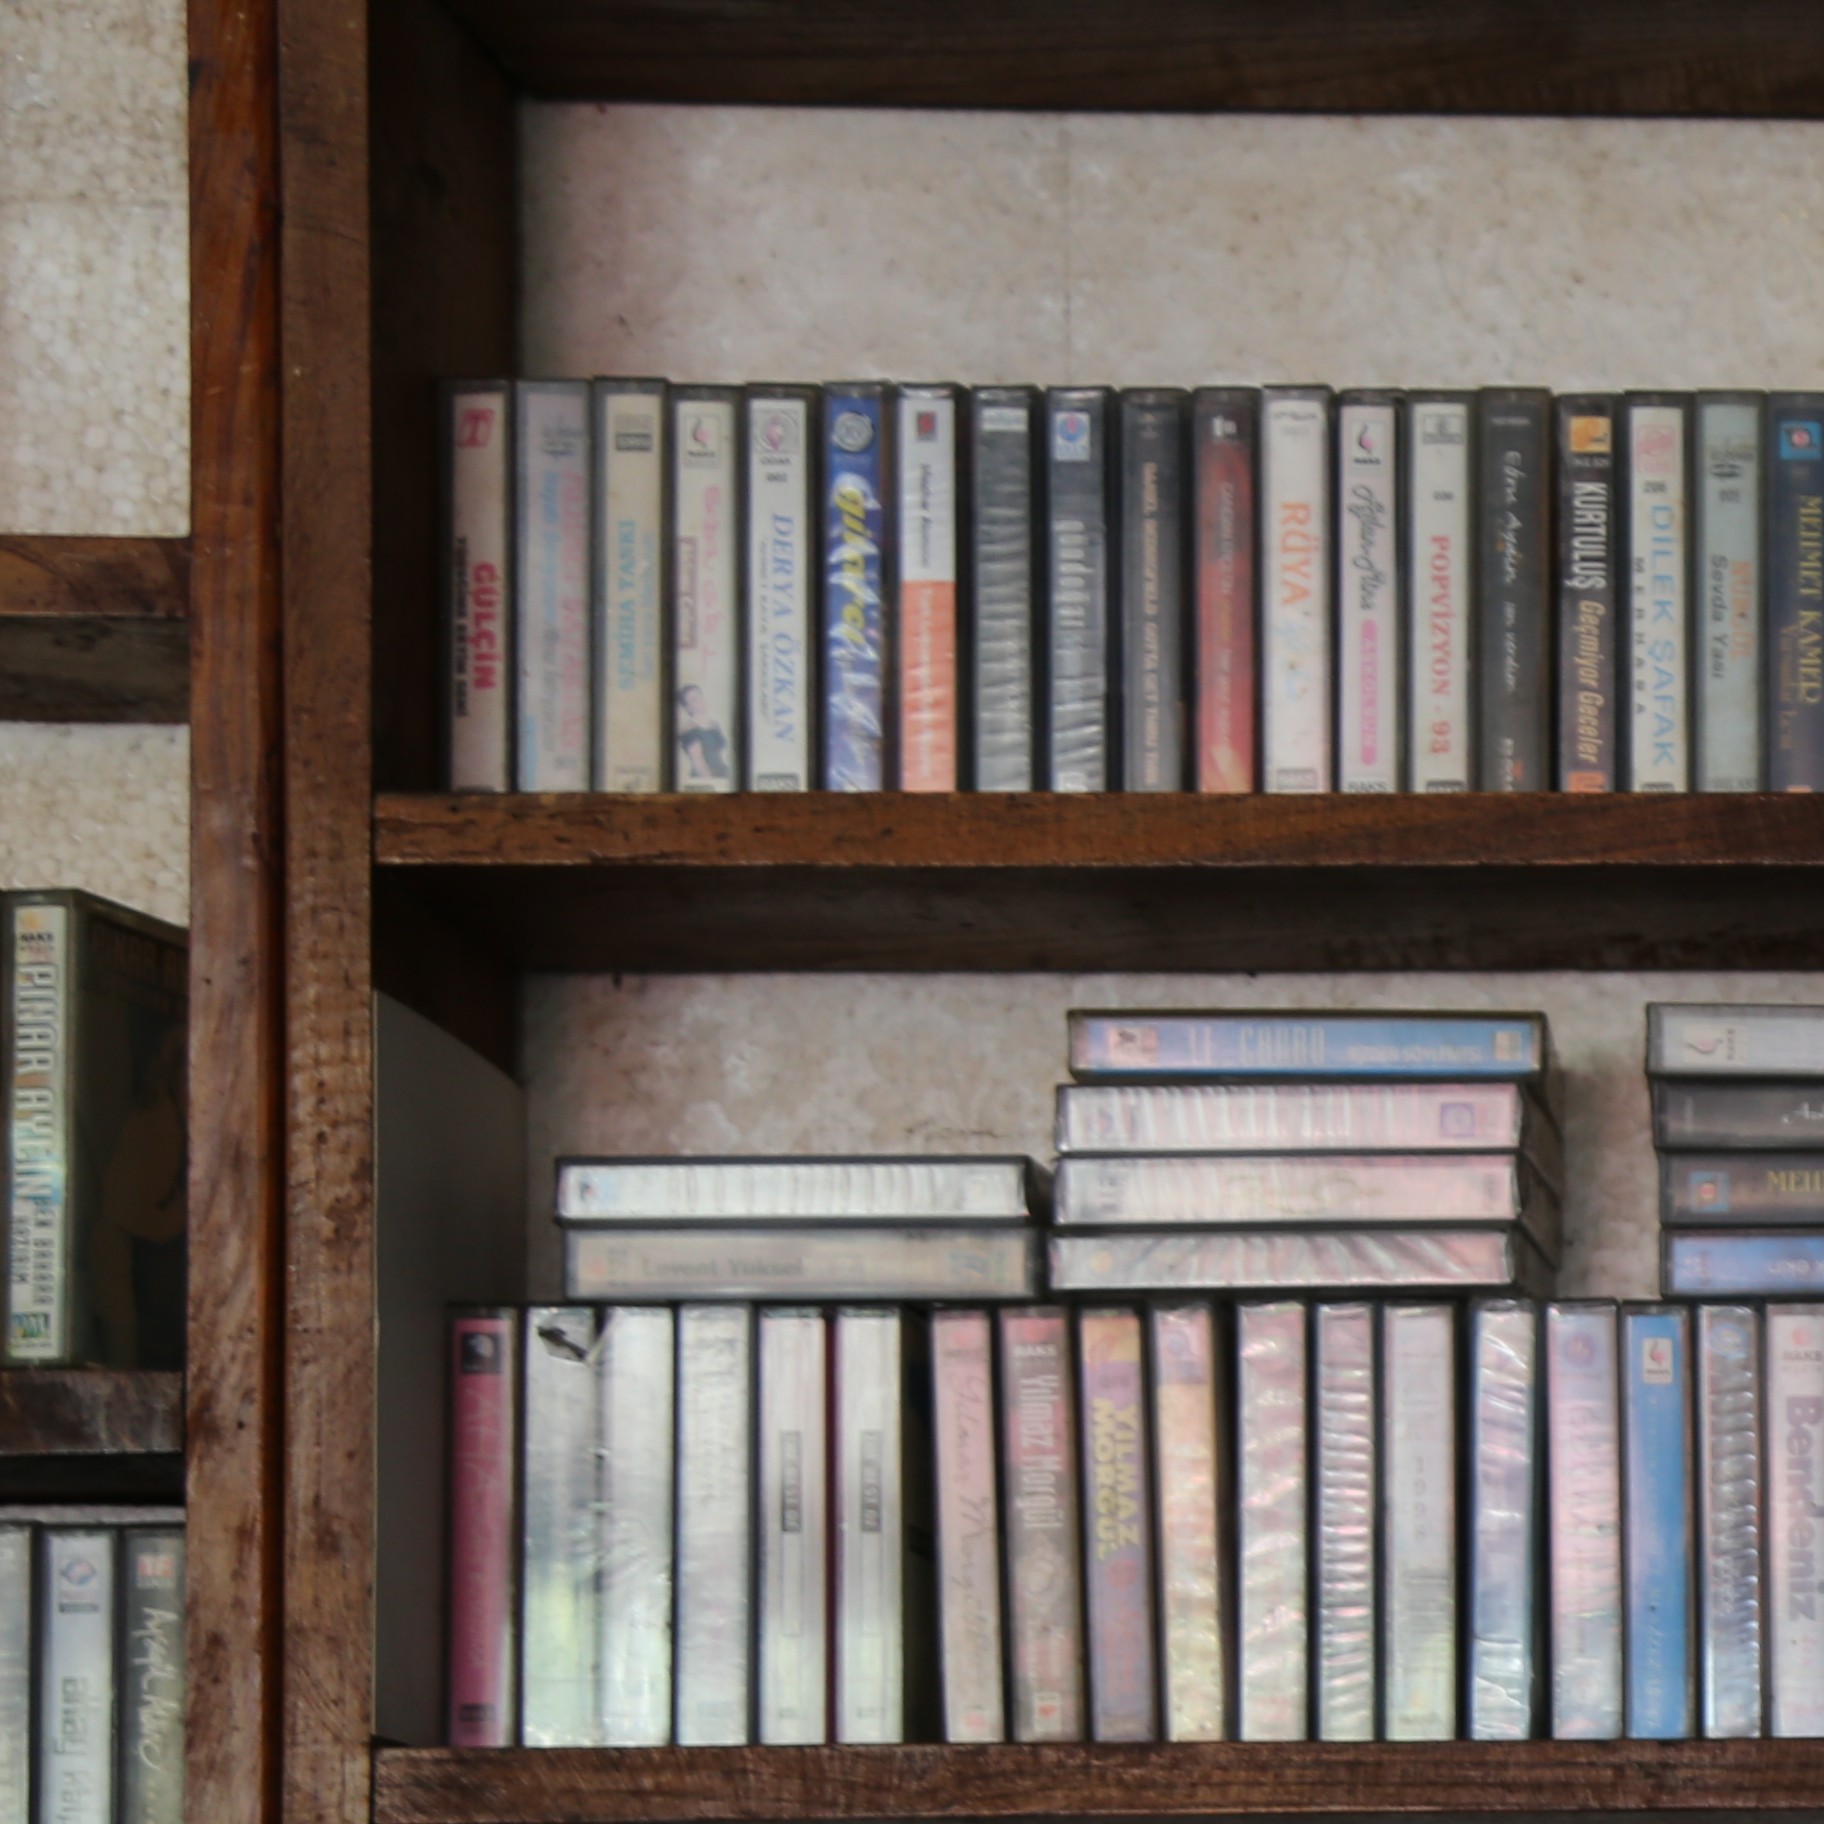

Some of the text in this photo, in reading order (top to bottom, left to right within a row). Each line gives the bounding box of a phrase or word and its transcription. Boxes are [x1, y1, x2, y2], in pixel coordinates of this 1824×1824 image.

[1282, 502, 1317, 605] RÜYA
[1712, 554, 1728, 679] Sevda Yası
[470, 563, 502, 689] GÜLÇİN
[772, 513, 800, 742] DERYA ÖZKAN
[1430, 535, 1453, 753] POPVİZYON 93
[1566, 481, 1608, 763] KURTULUŞ Geçmiyor Geceler
[1648, 504, 1676, 766] DİLEK ŞAFAK
[1143, 674, 1157, 701] GET
[15, 963, 58, 1075] PINAR
